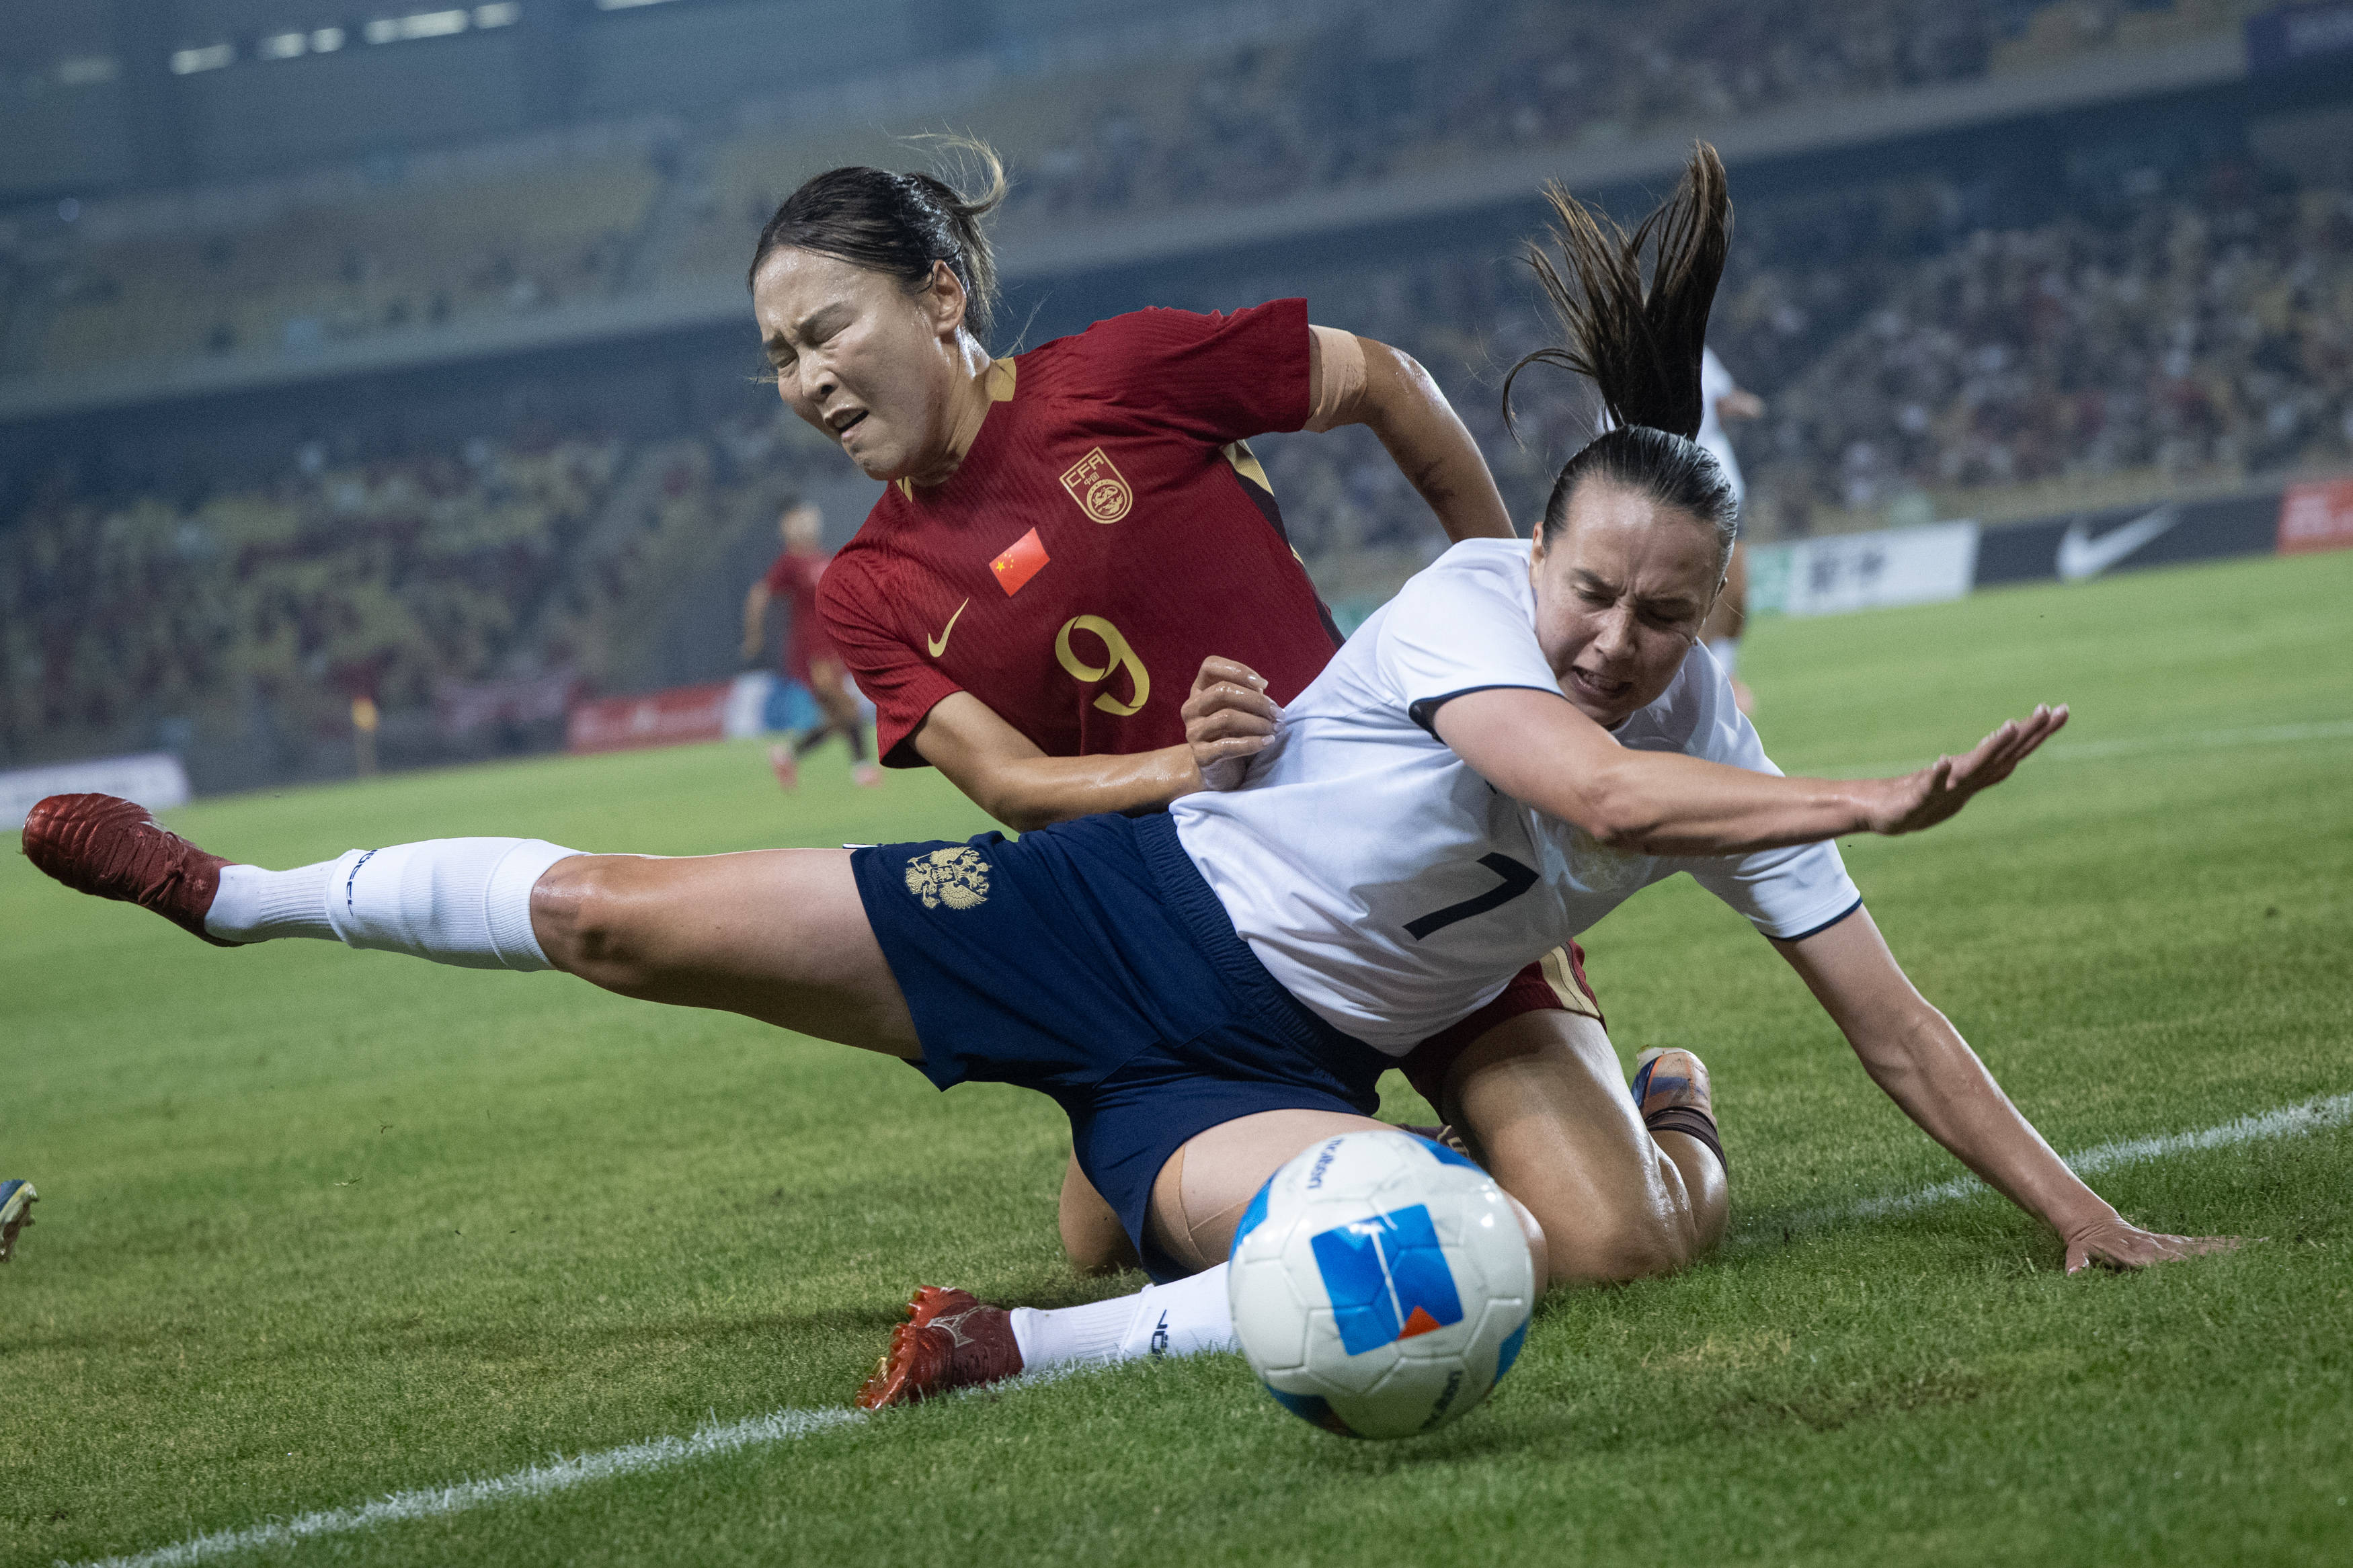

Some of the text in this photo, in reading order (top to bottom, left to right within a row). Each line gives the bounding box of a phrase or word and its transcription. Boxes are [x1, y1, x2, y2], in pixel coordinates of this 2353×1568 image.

[1066, 454, 1104, 488] CFA
[1084, 471, 1100, 485] 中国
[1055, 614, 1150, 716] 9
[1402, 852, 1540, 941] 7
